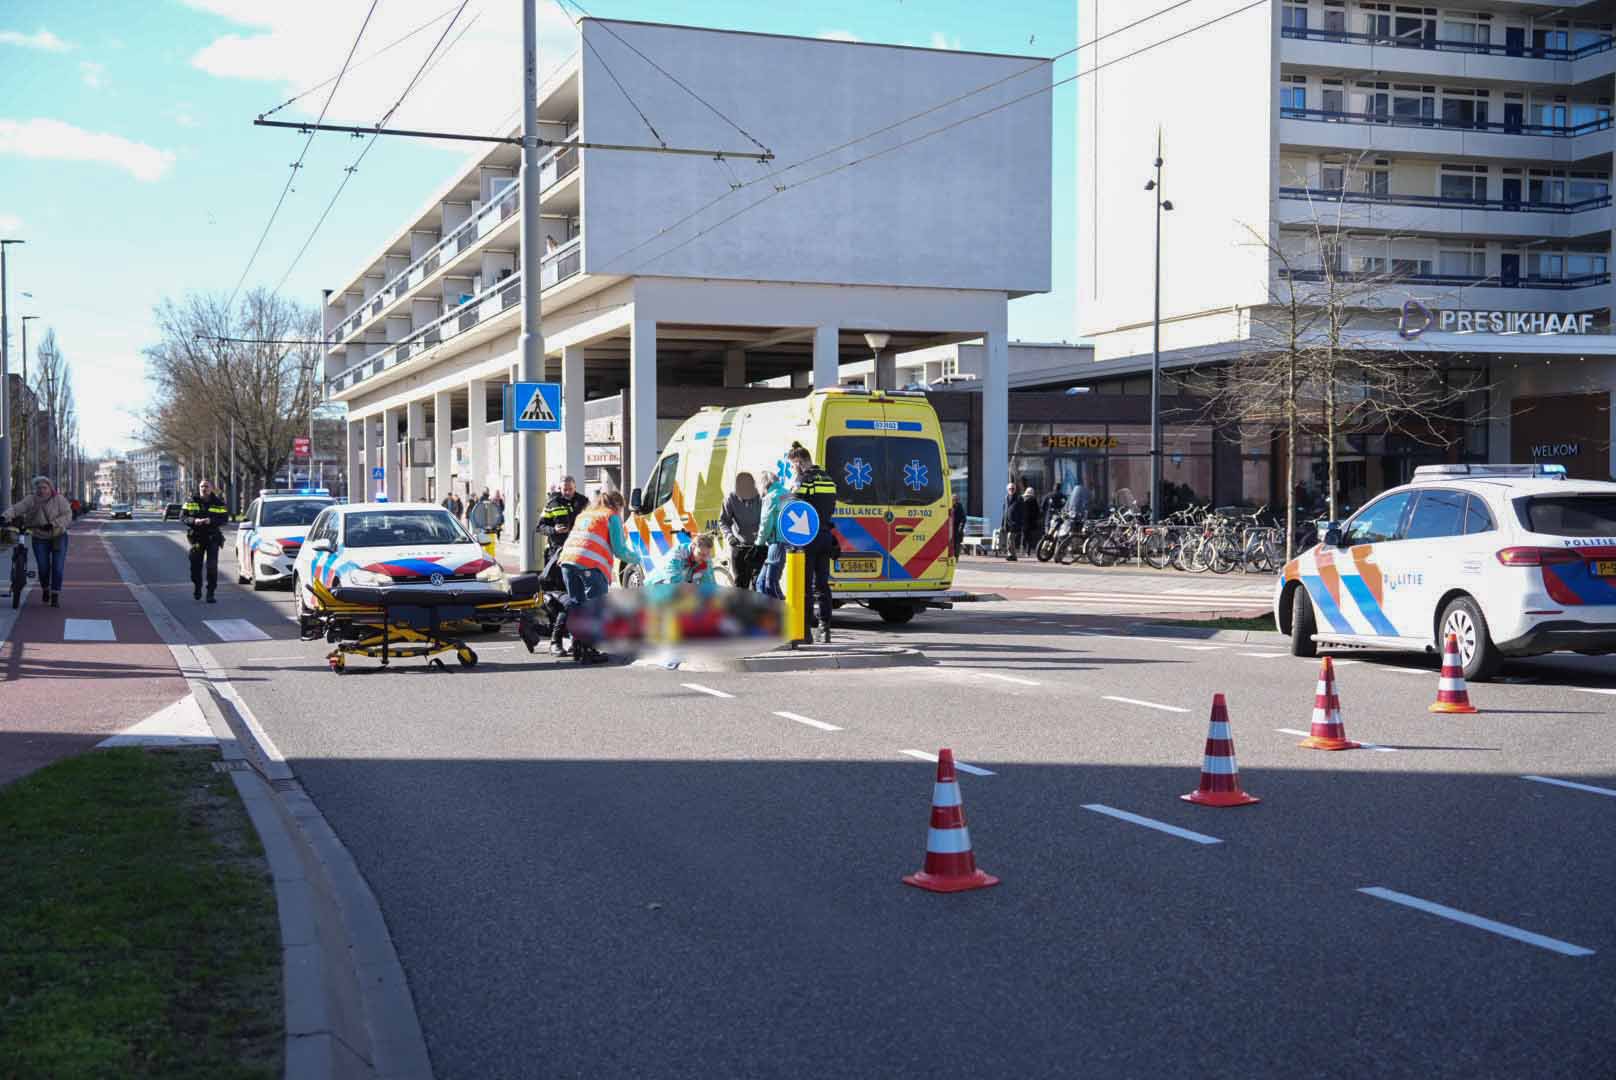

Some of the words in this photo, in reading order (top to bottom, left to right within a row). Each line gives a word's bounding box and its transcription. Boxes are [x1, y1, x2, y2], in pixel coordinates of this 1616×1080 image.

[1440, 310, 1593, 333] PRESIKHAAF
[1531, 443, 1578, 457] WELKOM
[1563, 538, 1616, 547] POLITIE
